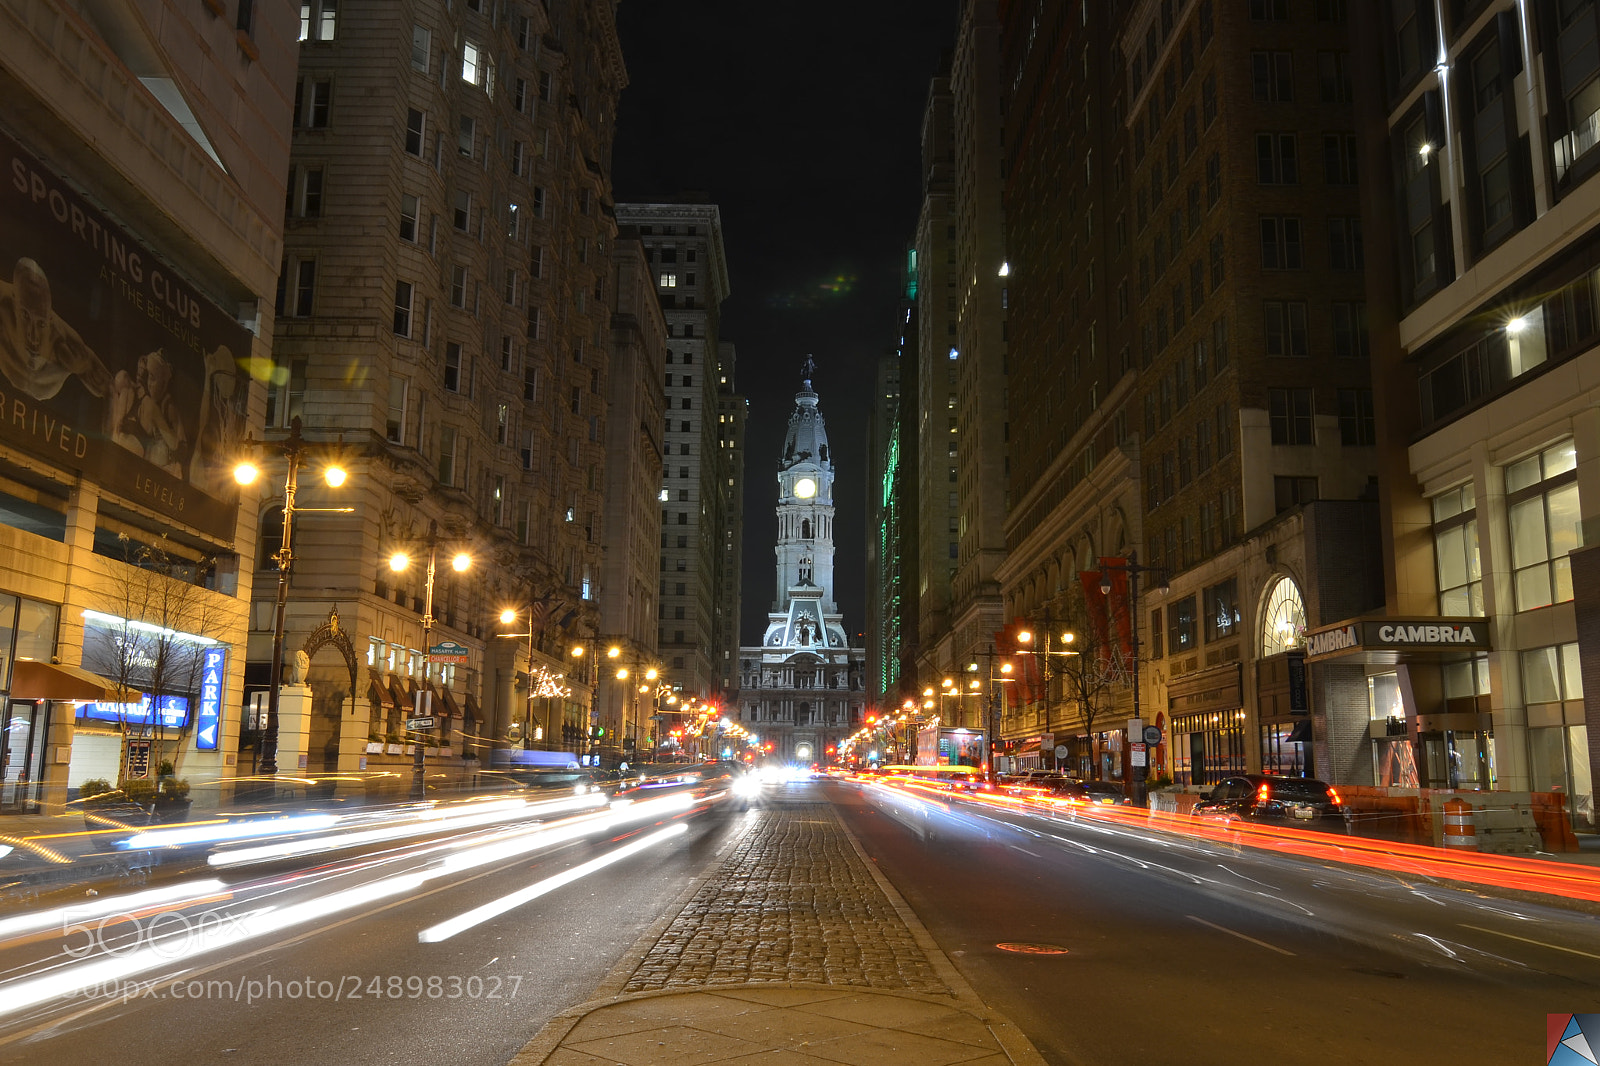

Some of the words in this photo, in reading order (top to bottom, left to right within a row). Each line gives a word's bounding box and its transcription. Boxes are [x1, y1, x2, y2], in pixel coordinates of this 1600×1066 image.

[11, 157, 143, 283] SPORTING
[151, 270, 200, 328] CLUB
[100, 265, 116, 288] AT
[120, 279, 143, 311] THE
[147, 299, 200, 353] BELLEVUE
[136, 473, 173, 506] LEVEL
[178, 497, 185, 512] 8
[202, 653, 220, 715] PARK
